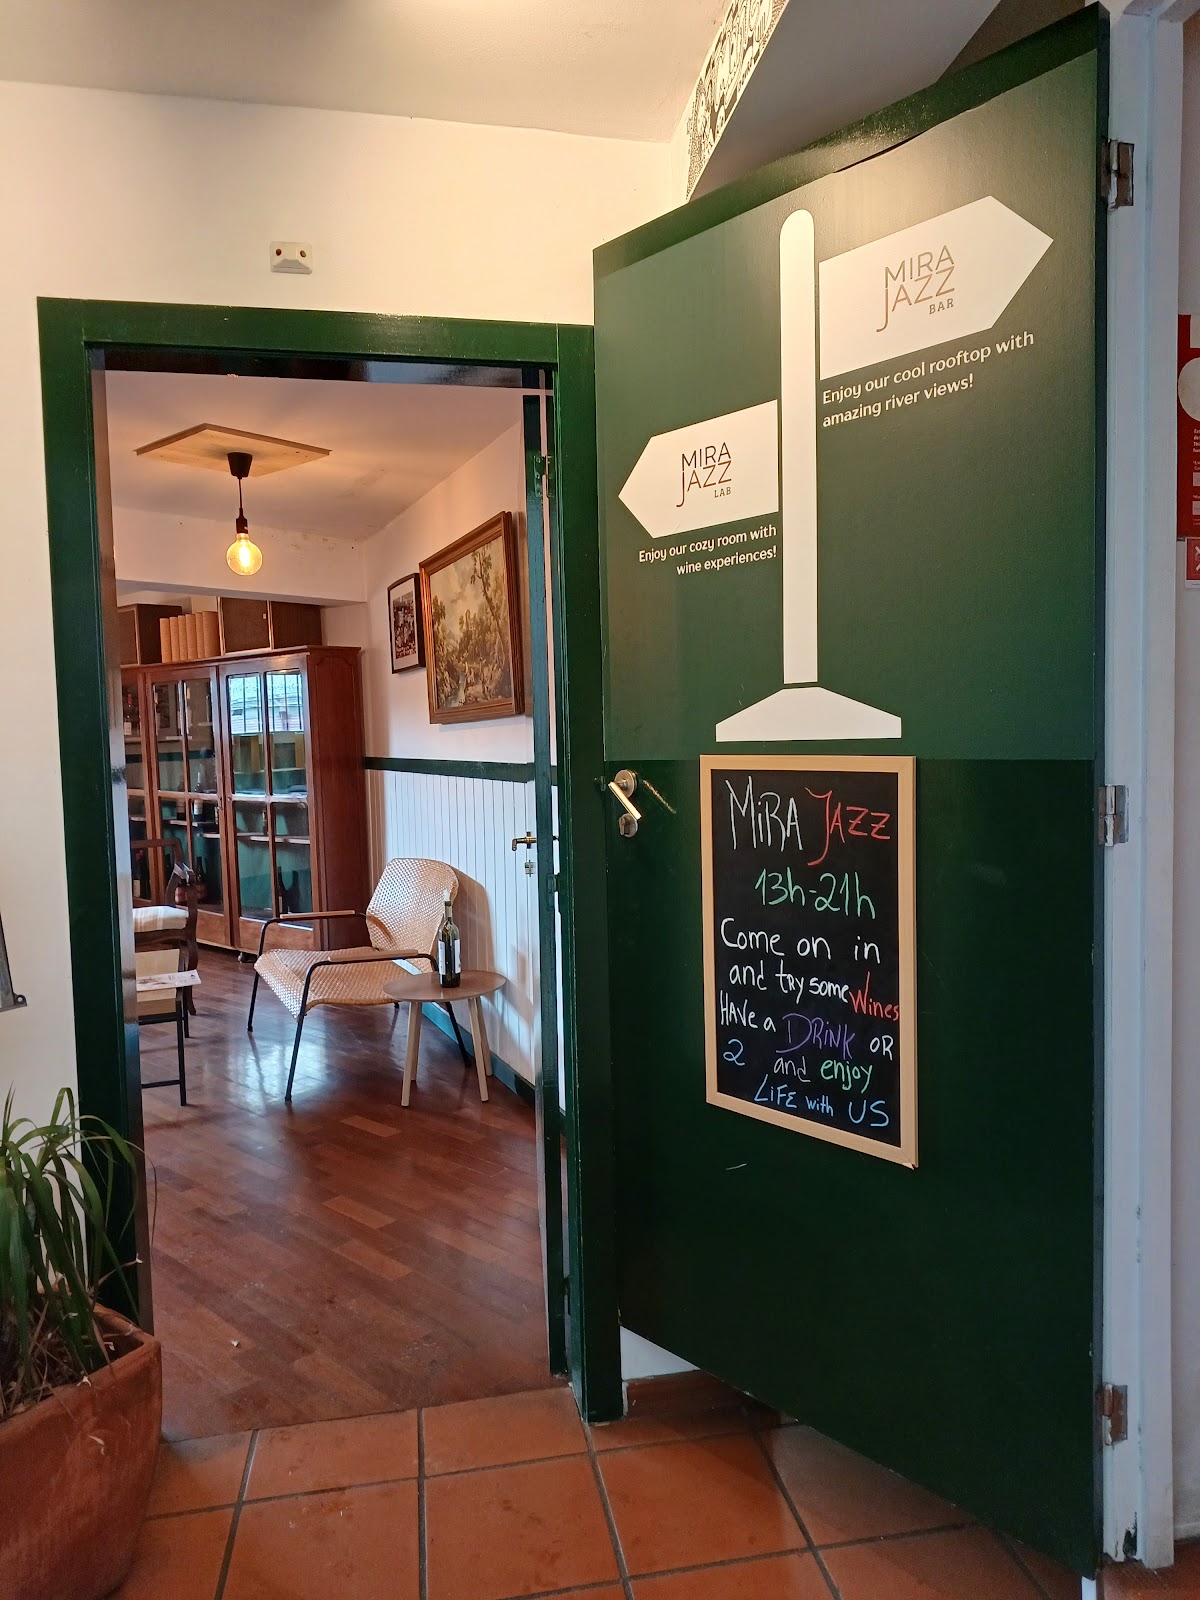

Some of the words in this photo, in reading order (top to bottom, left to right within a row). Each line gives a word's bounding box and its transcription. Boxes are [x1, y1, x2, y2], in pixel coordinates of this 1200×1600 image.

[885, 245, 954, 288] MIRA
[876, 266, 955, 332] JAZZ
[929, 298, 954, 315] BAR
[822, 383, 861, 405] Enjoy
[865, 375, 890, 393] our
[893, 361, 925, 383] cool
[929, 345, 991, 373] rooftop
[995, 331, 1034, 353] with
[822, 401, 882, 427] amazing
[885, 389, 920, 411] river
[924, 373, 974, 399] views!
[681, 442, 731, 471] MIRA
[676, 460, 732, 508] JAZZ
[714, 487, 732, 499] LAB
[639, 548, 667, 563] Enjoy
[669, 543, 687, 557] our
[689, 538, 715, 554] cozy
[717, 532, 747, 547] room
[750, 524, 777, 540] with
[676, 561, 702, 575] wine
[704, 545, 777, 571] experiences!
[804, 786, 891, 866] JAZZ
[754, 866, 876, 920] 13h-21h
[720, 917, 785, 956] Come
[797, 936, 831, 960] on
[854, 935, 880, 964] in
[729, 959, 767, 991] and
[809, 977, 849, 1003] some
[849, 971, 899, 1021] Wines
[763, 1017, 777, 1032] a
[773, 1056, 811, 1082] and
[820, 1059, 873, 1094] enjoy
[805, 1094, 834, 1117] with
[848, 1100, 890, 1127] US
